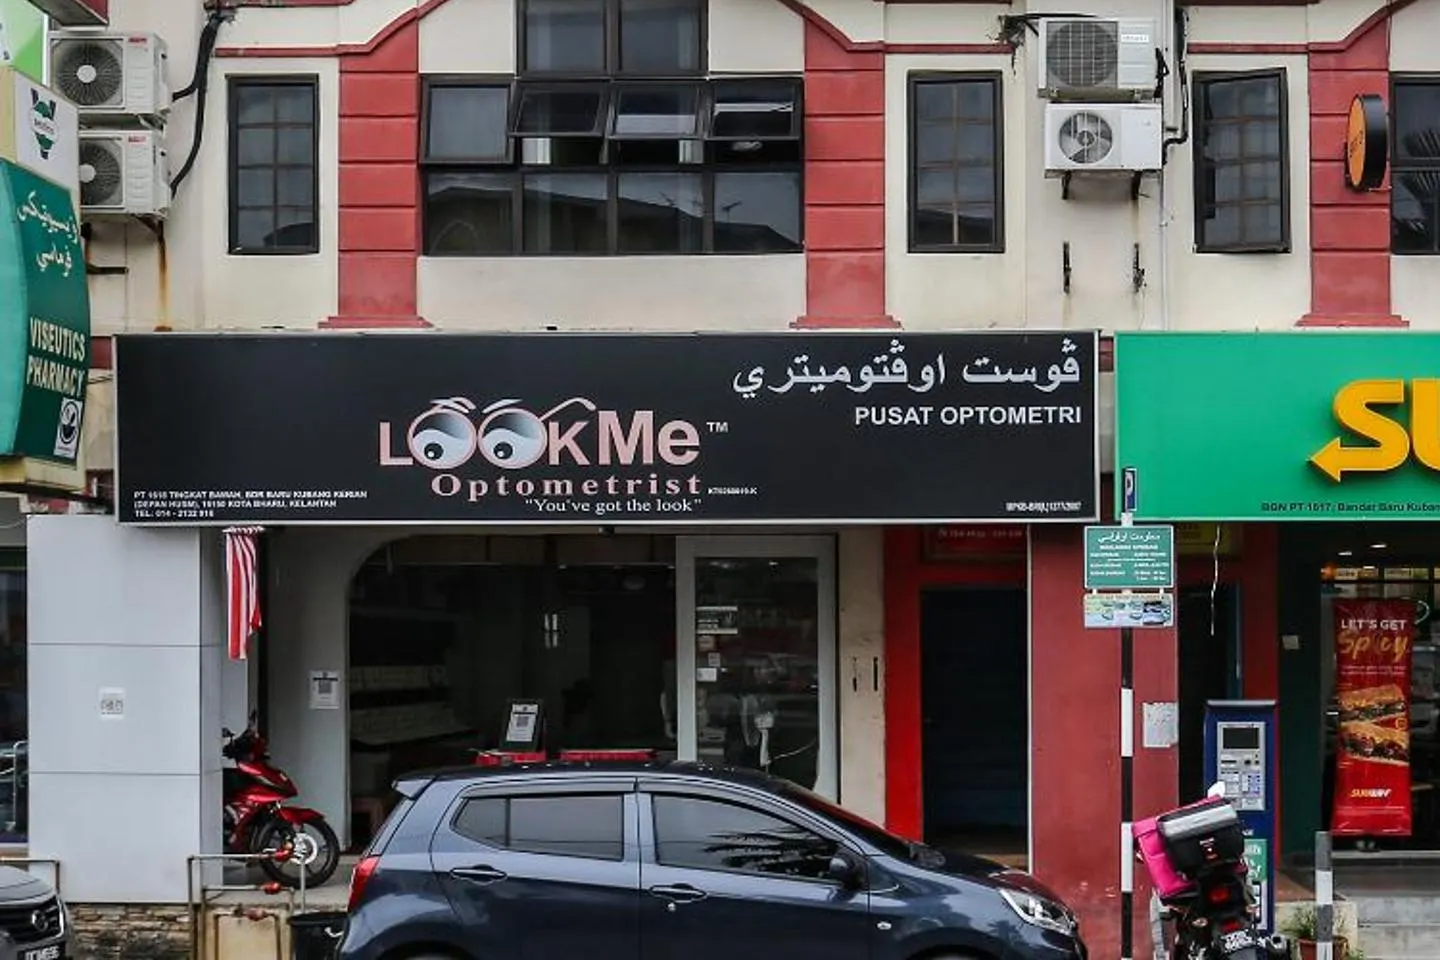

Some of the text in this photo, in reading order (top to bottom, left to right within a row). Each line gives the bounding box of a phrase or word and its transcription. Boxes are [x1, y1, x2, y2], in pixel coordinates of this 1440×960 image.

[29, 316, 87, 363] VISEUTICS
[26, 354, 86, 398] PHARMACY
[854, 405, 1082, 426] PUSAT OPTOMETRI
[430, 473, 701, 502] Optometrist
[595, 502, 621, 515] got
[627, 498, 651, 512] the
[1379, 619, 1408, 631] GET
